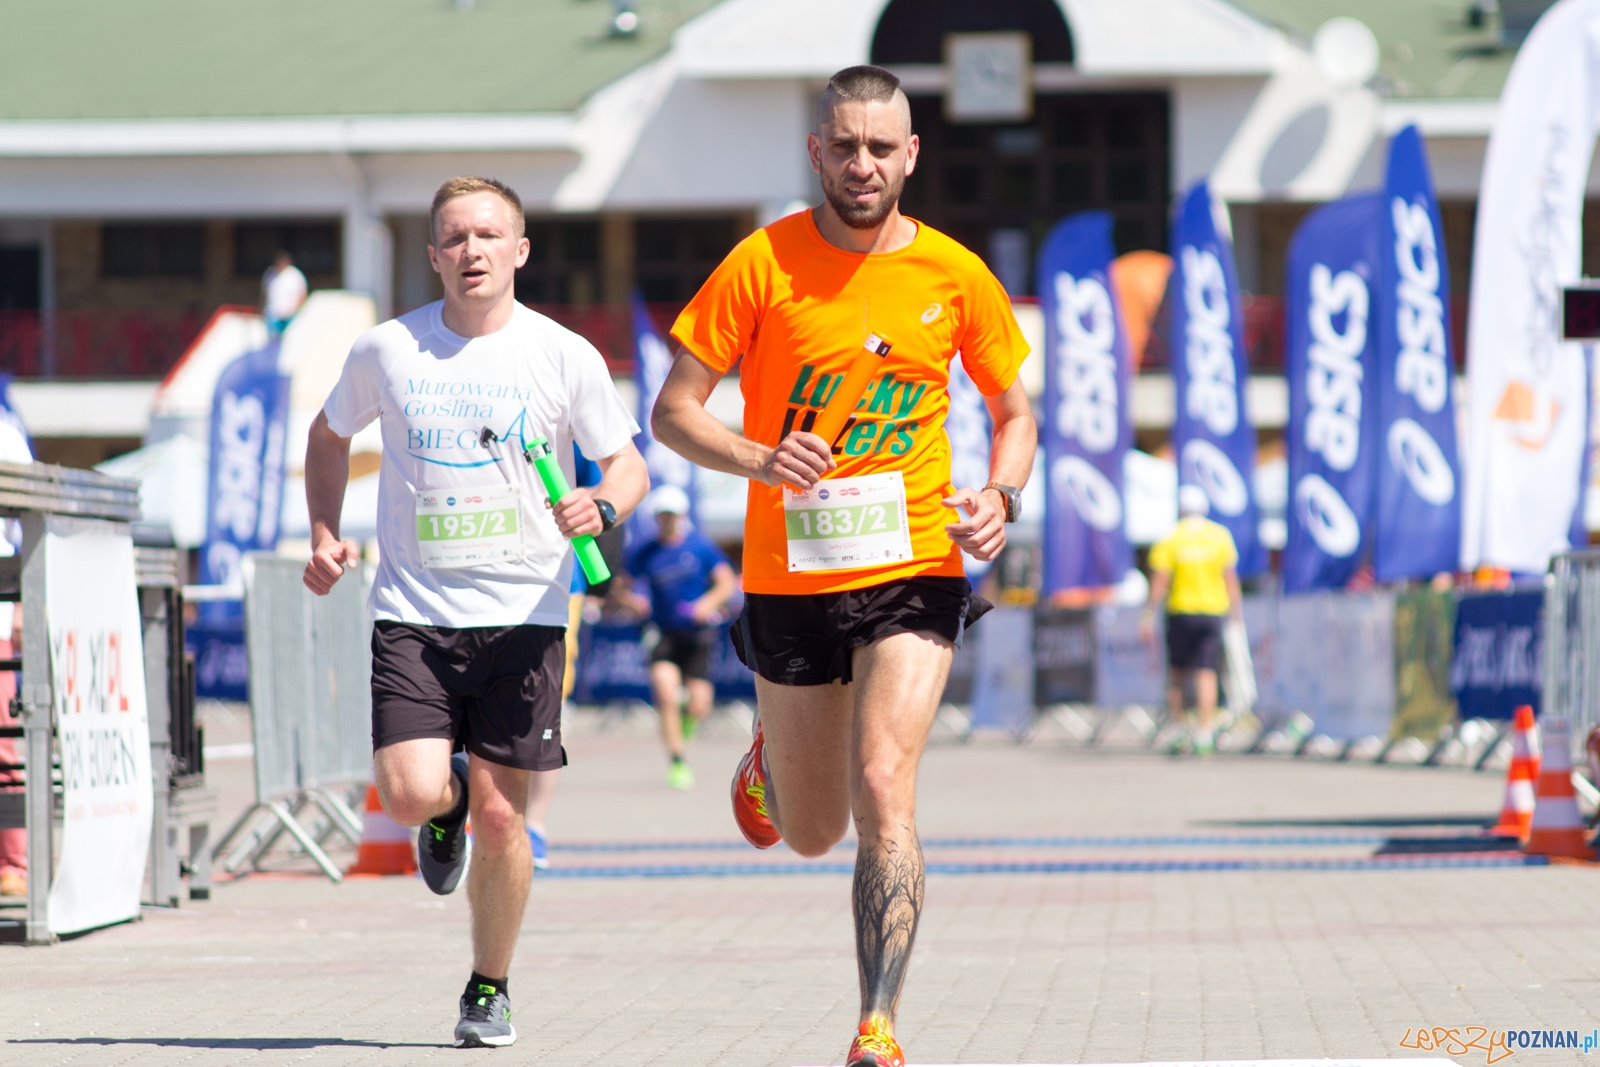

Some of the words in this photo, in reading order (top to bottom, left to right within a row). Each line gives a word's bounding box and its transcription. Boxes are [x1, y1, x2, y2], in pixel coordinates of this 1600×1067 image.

[1393, 196, 1449, 413] asics
[1056, 270, 1119, 454] asics
[1306, 262, 1370, 471] asics
[403, 379, 531, 401] Murowana
[404, 399, 493, 418] Goślina
[429, 511, 506, 537] 195/2
[799, 505, 887, 536] 183/2
